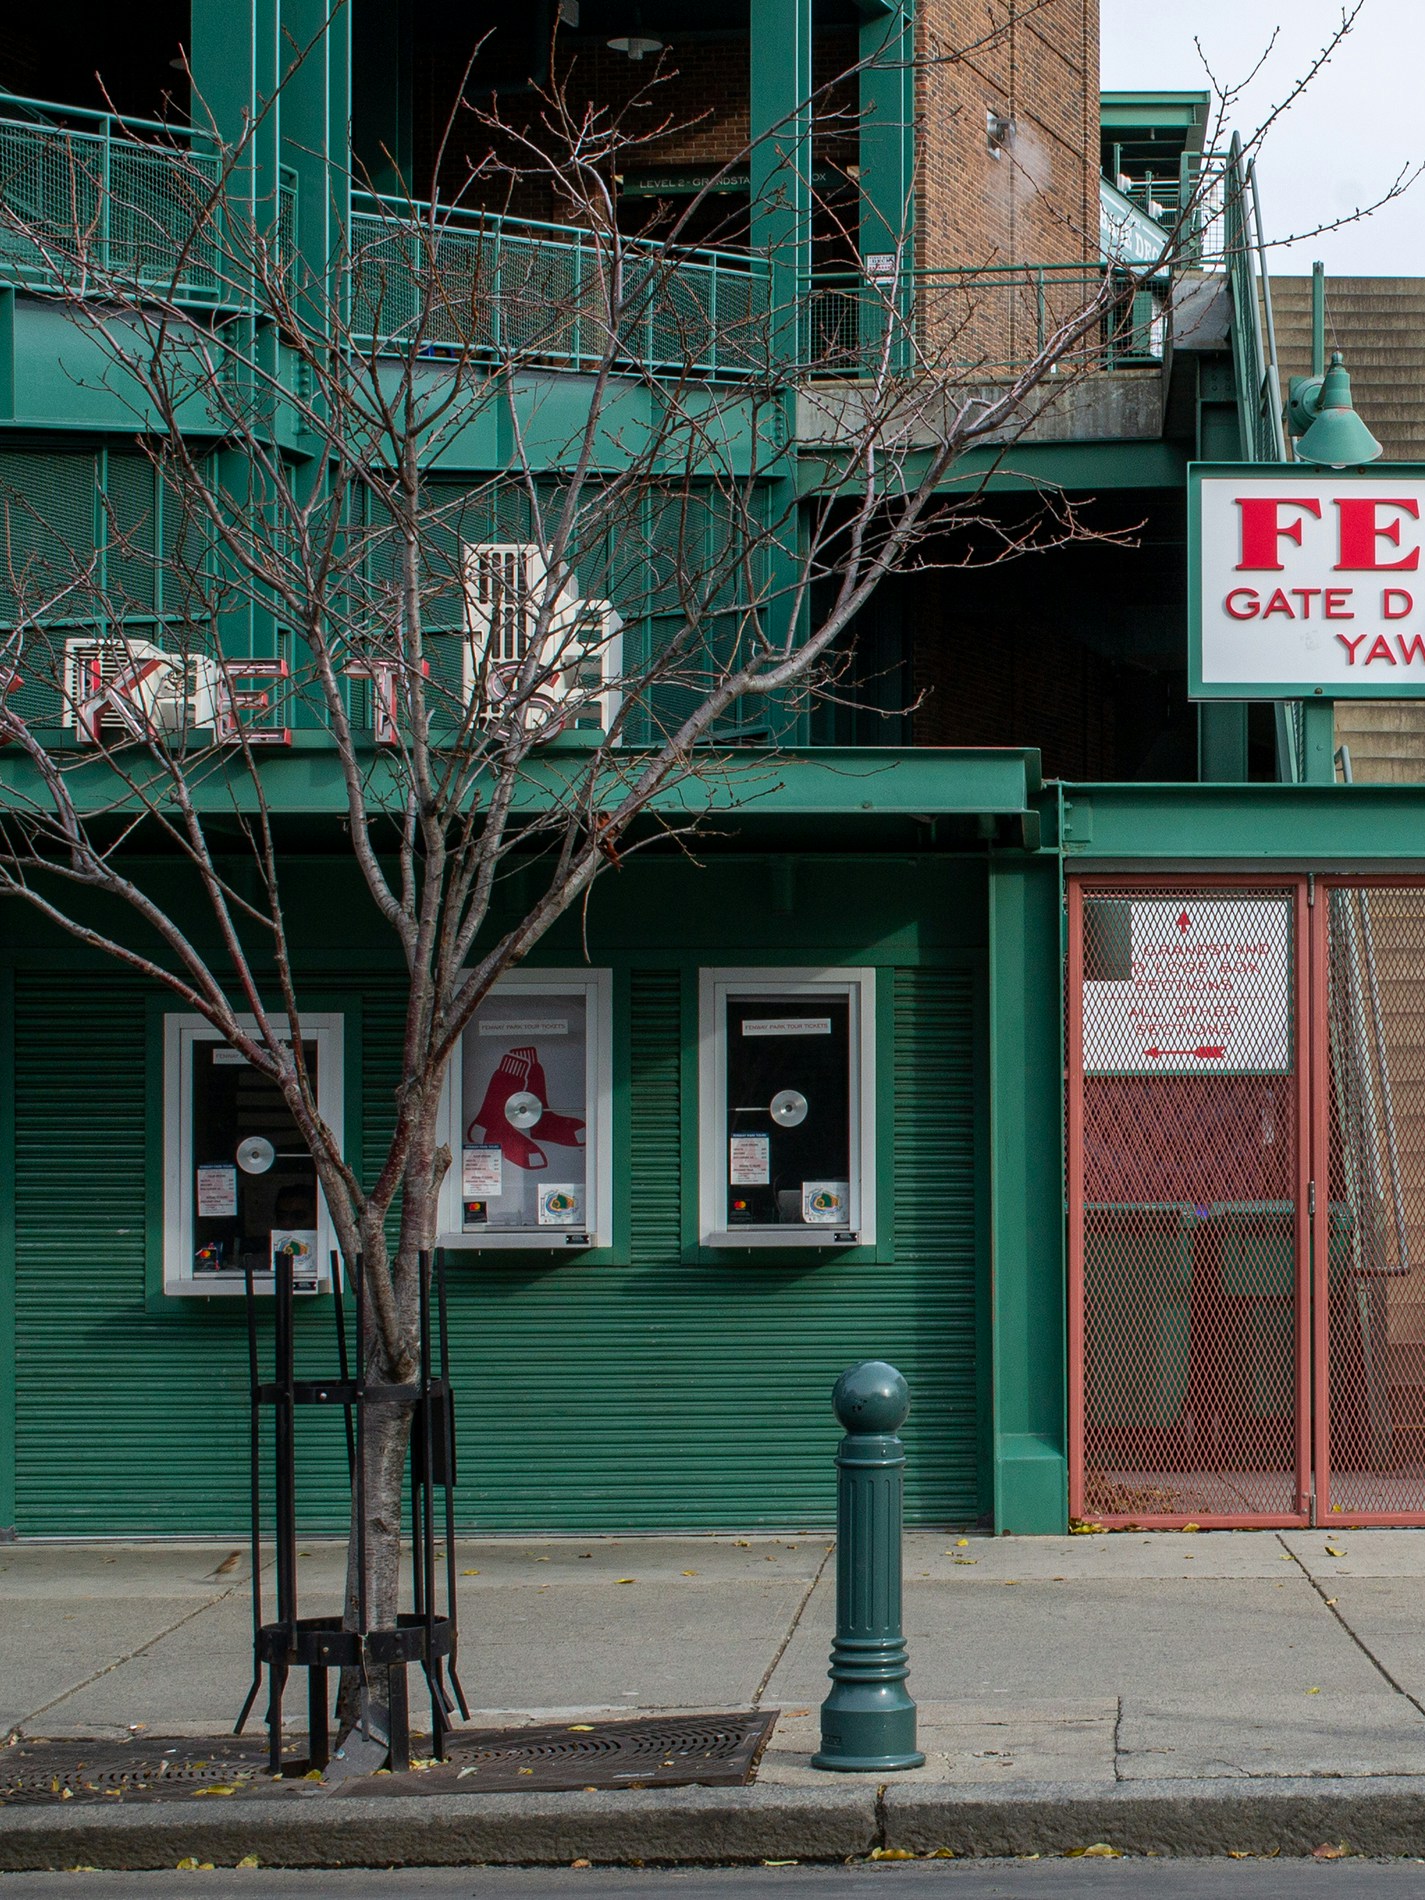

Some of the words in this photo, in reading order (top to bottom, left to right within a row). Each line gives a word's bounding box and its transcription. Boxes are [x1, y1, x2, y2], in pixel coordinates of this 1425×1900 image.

[640, 179, 675, 189] LEVEL
[677, 179, 685, 188] 2
[692, 176, 751, 187] GRNDSTA
[1225, 587, 1355, 620] GATE
[1383, 588, 1414, 620] D
[1143, 943, 1270, 956] GRANDSTAND
[1219, 962, 1261, 974] BOX
[1135, 979, 1234, 991] SECTIONS
[1129, 1006, 1163, 1018] ALL
[1175, 1006, 1239, 1018] OTHER
[1135, 1024, 1233, 1036] SECTIONS
